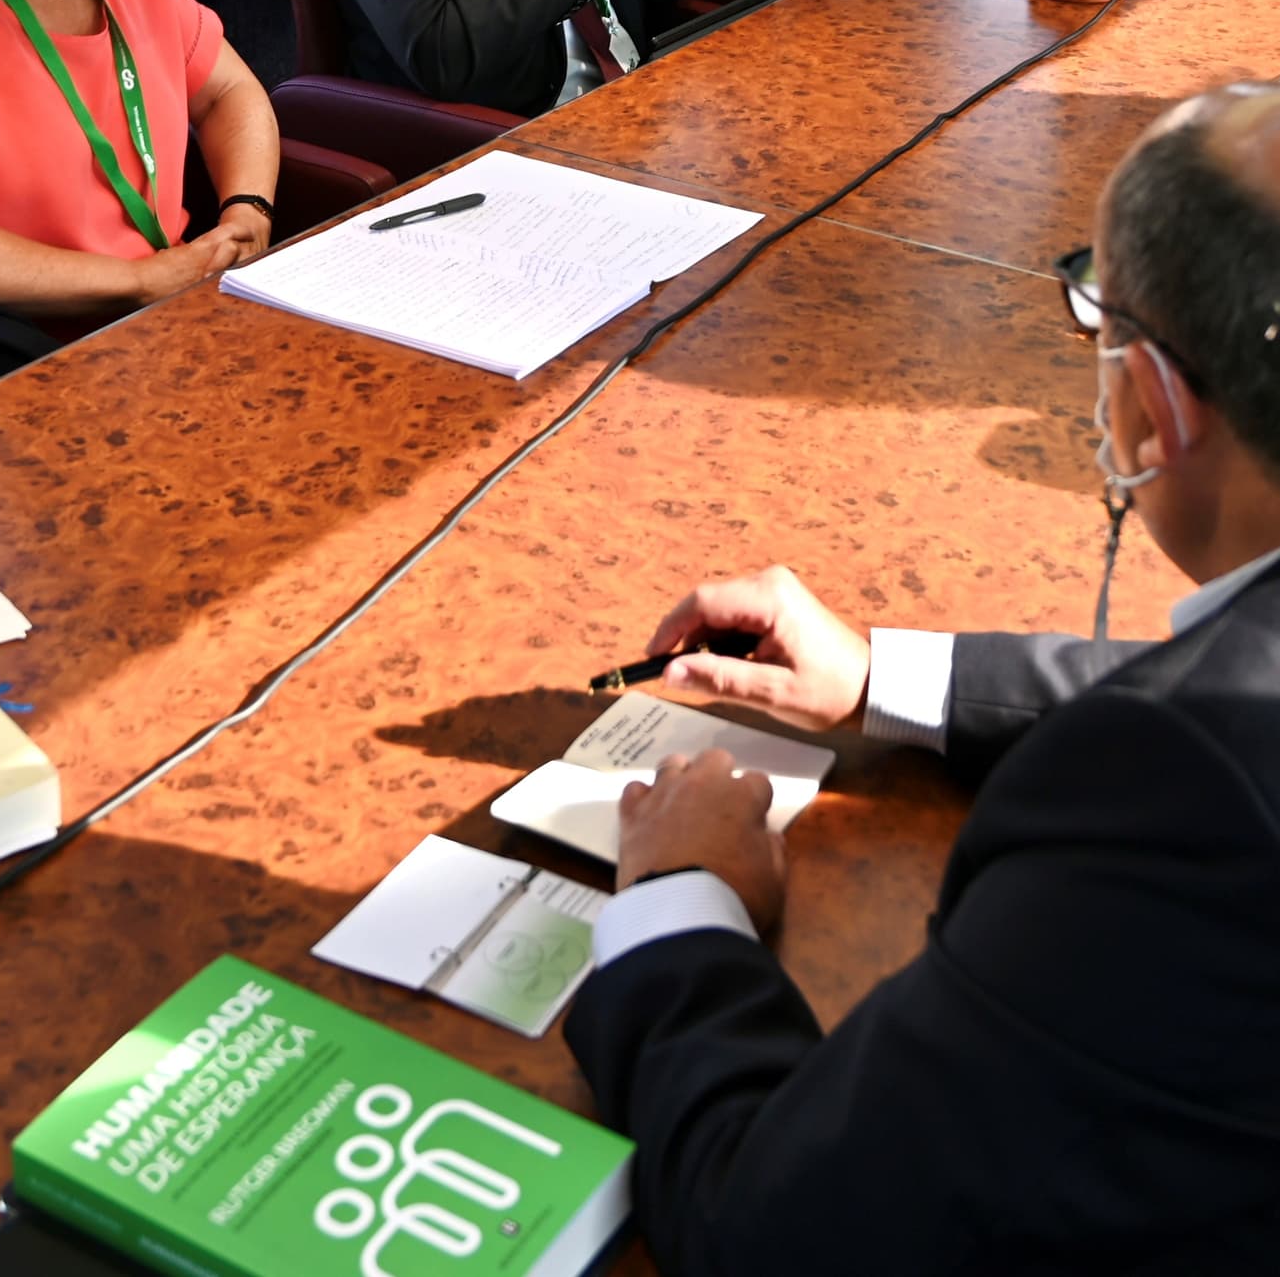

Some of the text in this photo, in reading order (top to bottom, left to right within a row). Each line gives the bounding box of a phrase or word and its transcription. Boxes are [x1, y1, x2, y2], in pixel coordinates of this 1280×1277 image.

[71, 980, 274, 1160] HUMANIDADE
[108, 1113, 179, 1176] UMA
[168, 1013, 286, 1119] HISTÓRIA
[136, 1146, 186, 1193] DE
[174, 1024, 317, 1156] ESPERANÇA
[208, 1153, 276, 1226] RUTGER
[273, 1077, 356, 1159] BREGMAN
